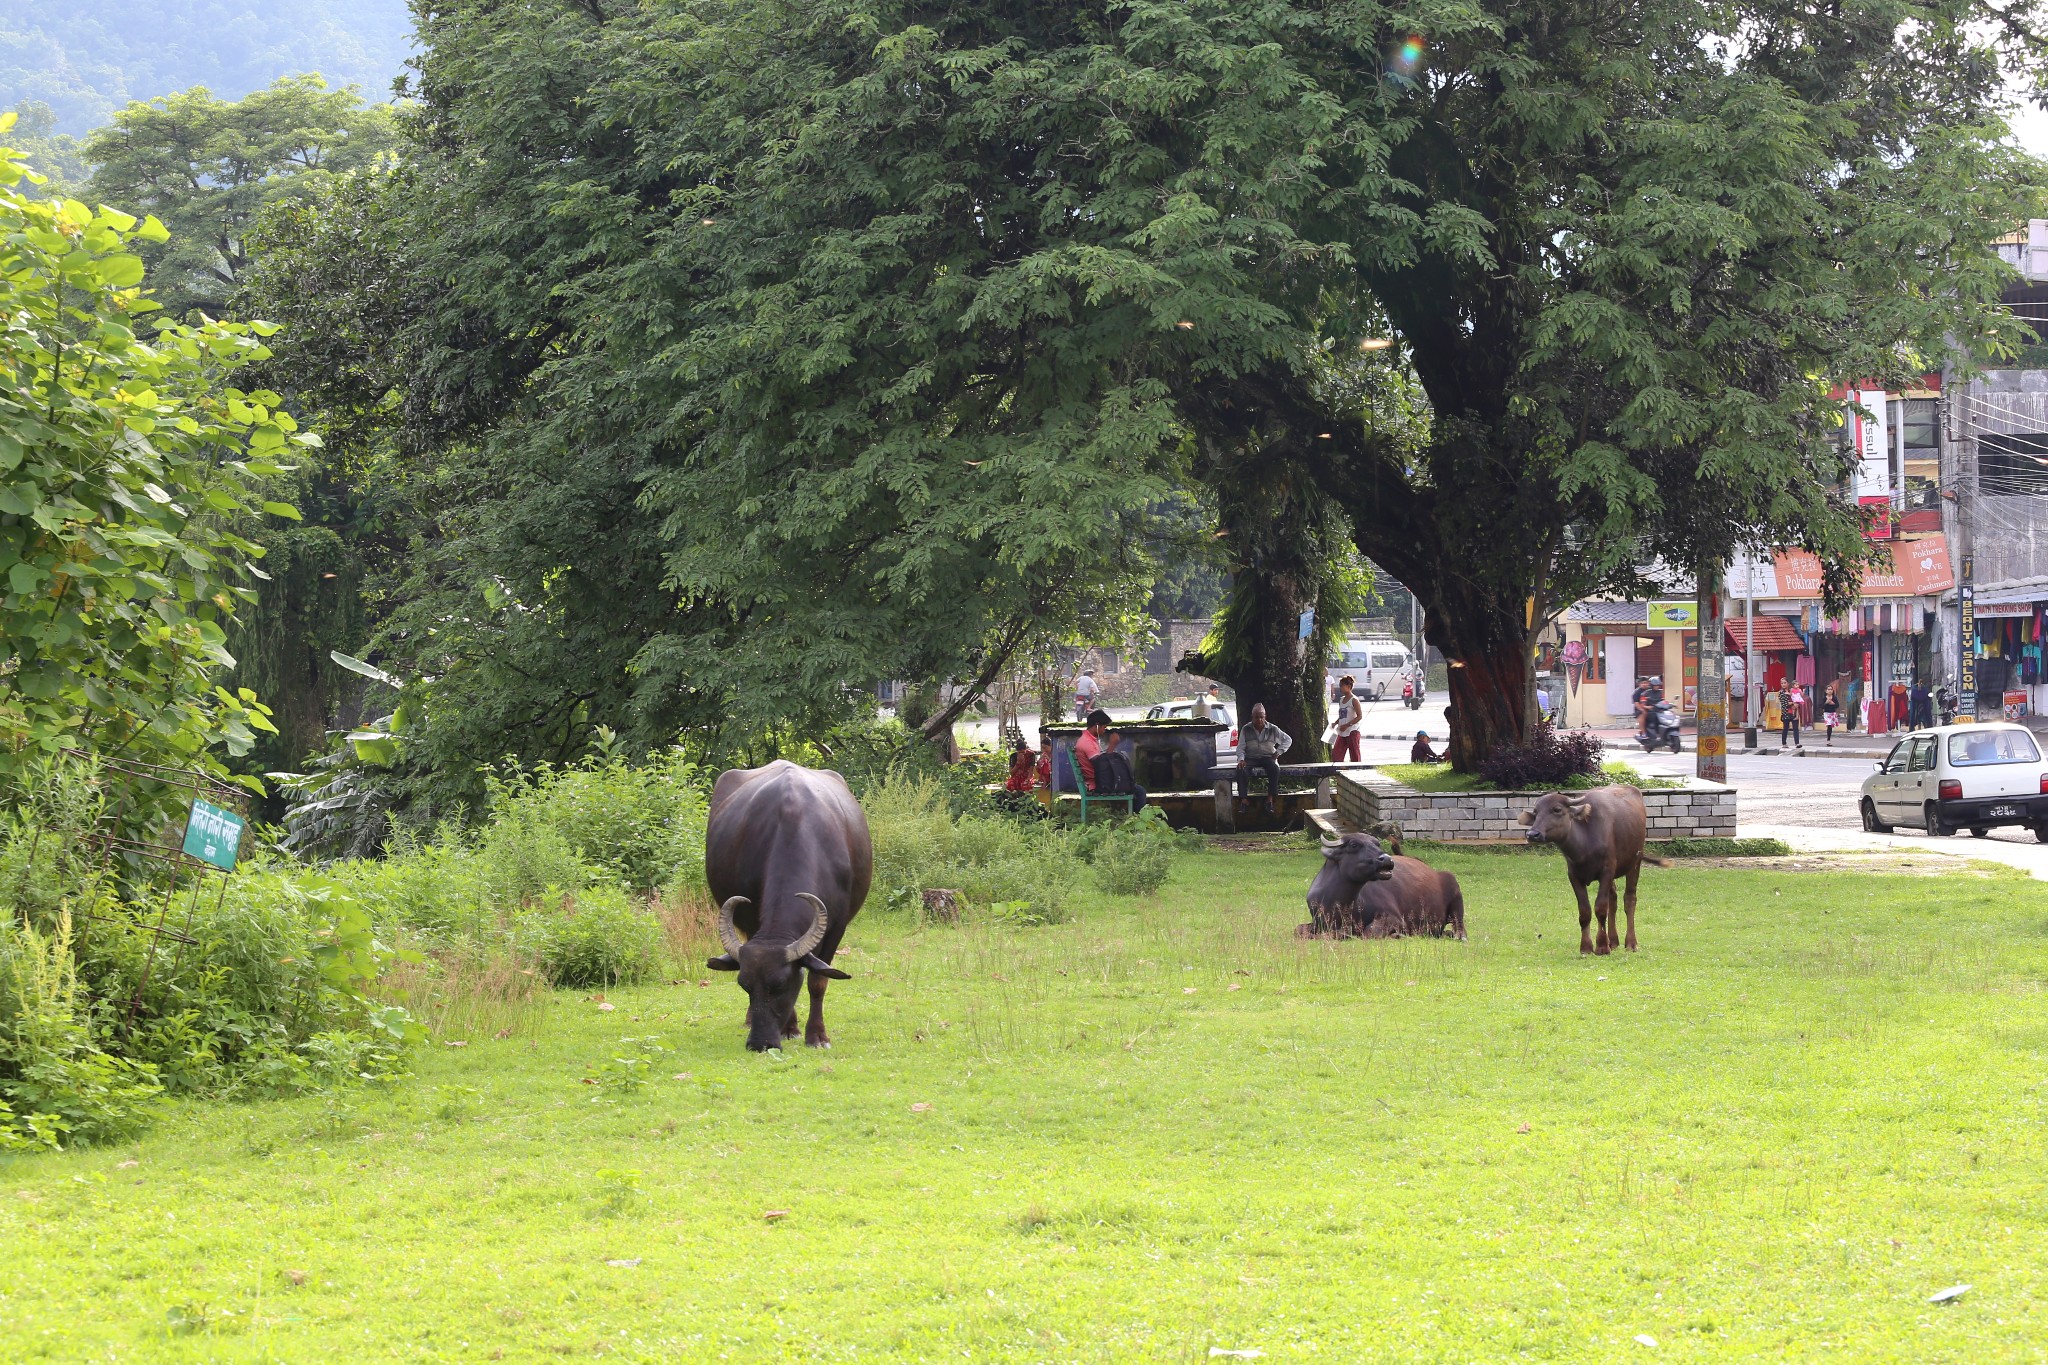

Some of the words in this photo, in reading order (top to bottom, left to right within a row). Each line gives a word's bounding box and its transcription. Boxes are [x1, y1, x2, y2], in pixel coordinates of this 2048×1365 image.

[1864, 404, 1878, 455] ntssul
[1912, 547, 1943, 559] Pokhara
[1785, 574, 1821, 590] Pokhara
[1861, 574, 1905, 589] Cashmere
[1918, 579, 1952, 592] Cashmere
[1992, 604, 2017, 613] TREKKING
[2018, 603, 2032, 612] SHOP
[1962, 601, 1974, 648] BEAUTY
[1962, 652, 1974, 690] SALON
